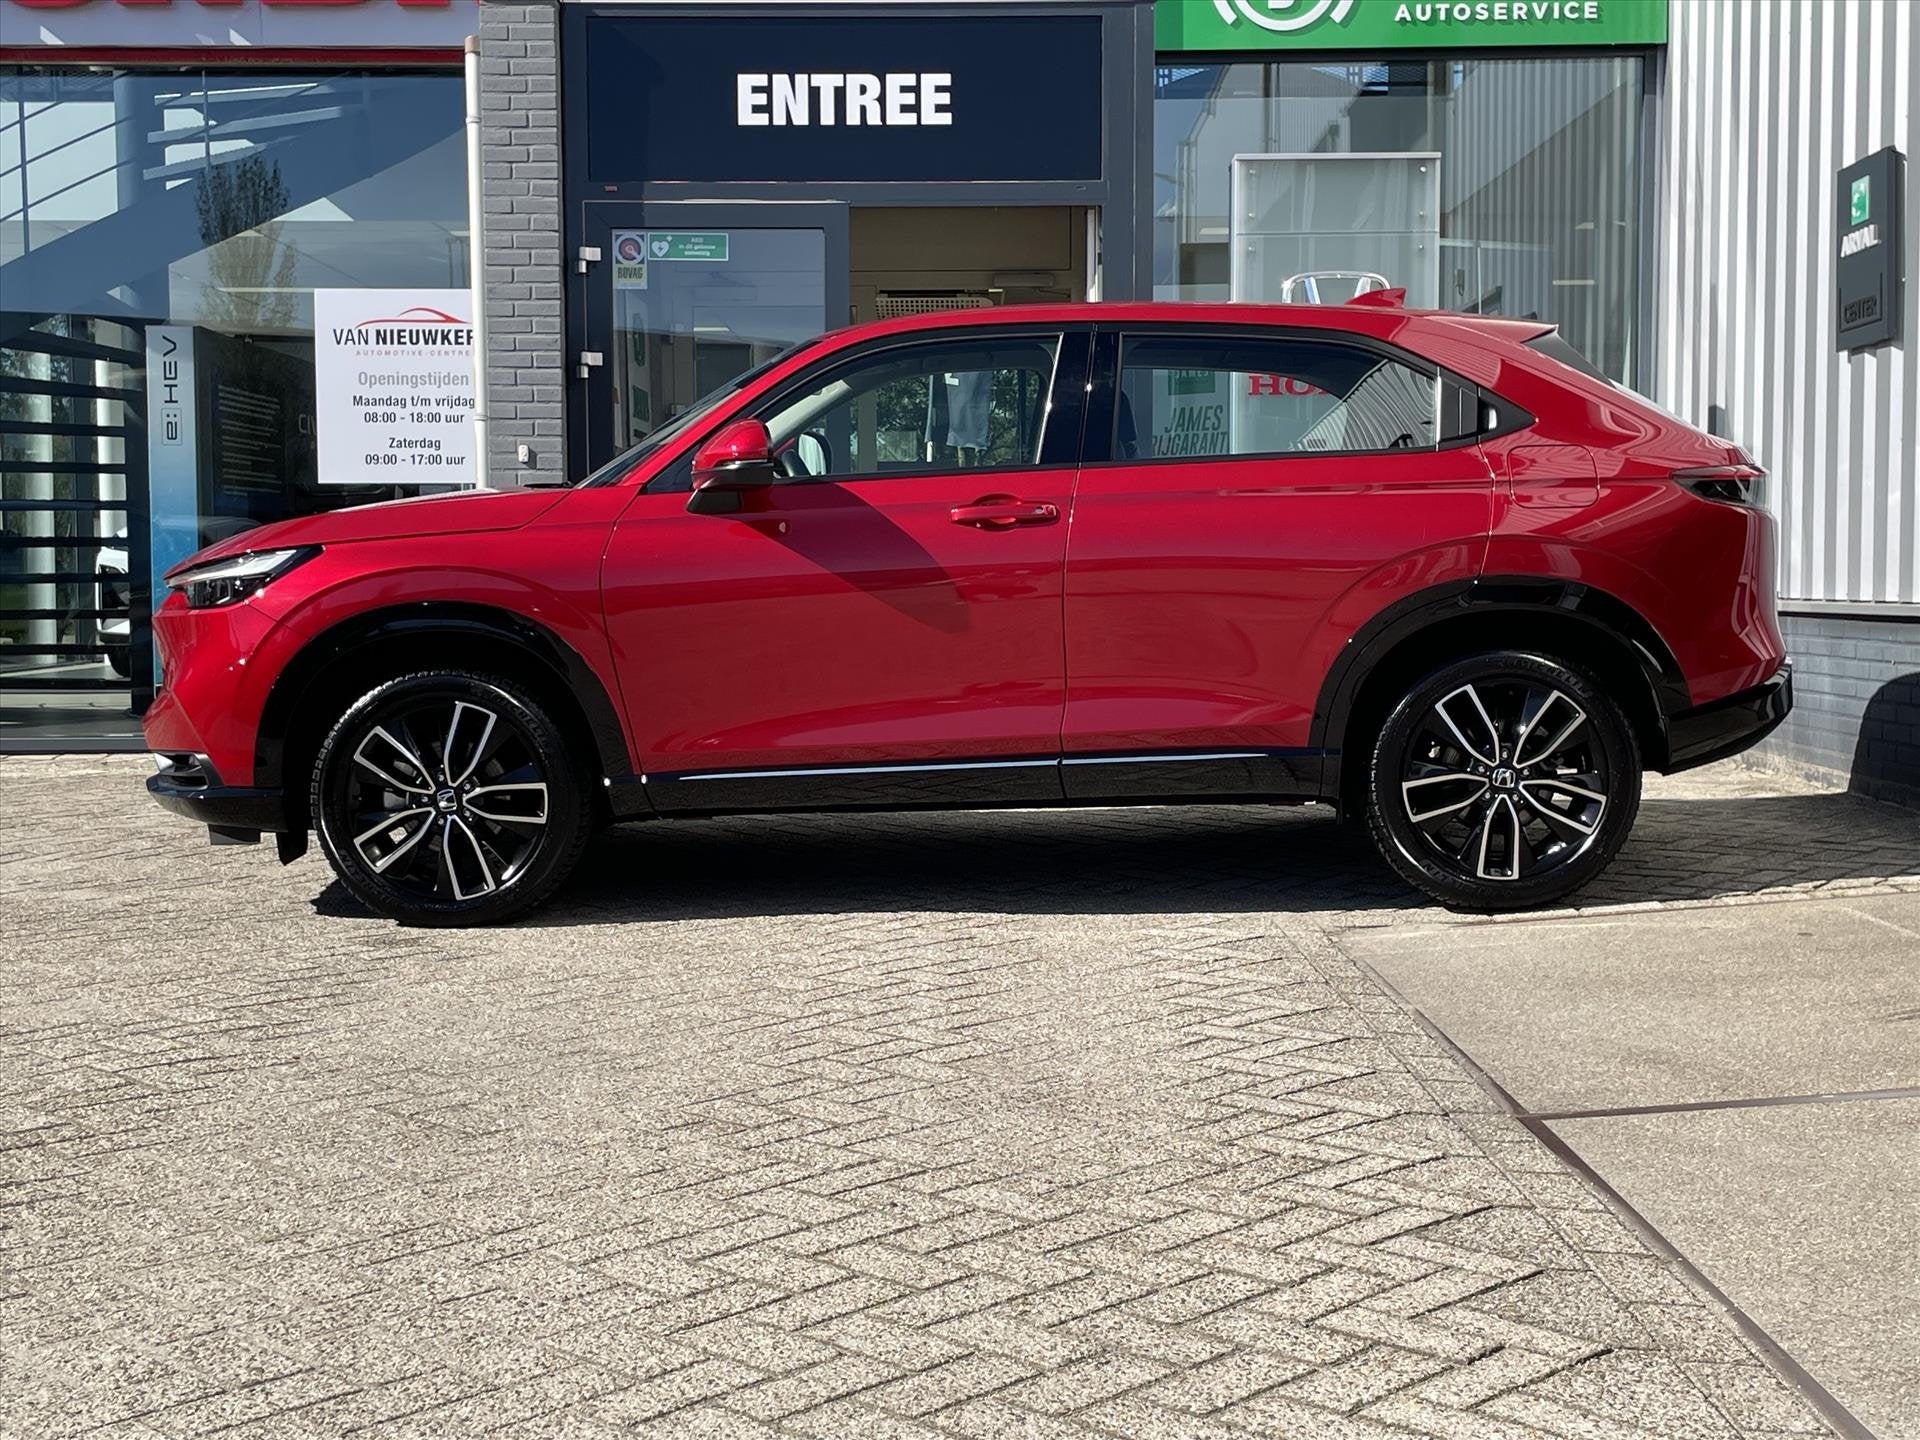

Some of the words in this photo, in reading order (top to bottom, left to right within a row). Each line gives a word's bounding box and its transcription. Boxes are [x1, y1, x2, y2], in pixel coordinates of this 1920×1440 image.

[1394, 1, 1599, 21] AUTOSERVICE
[737, 73, 952, 126] ENTREE
[1840, 223, 1880, 258] ARVAL
[617, 266, 644, 279] BOVAG
[333, 328, 369, 346] VAN
[358, 371, 470, 388] Openingstijden
[1248, 373, 1329, 396] HO
[352, 395, 407, 408] Maandag
[410, 395, 431, 407] t/m
[435, 395, 475, 408] vrijdag
[364, 412, 397, 423] 08:00
[409, 412, 441, 423] 18:00
[445, 414, 465, 423] uur
[1164, 405, 1224, 434] JAMES
[389, 437, 441, 450] Zaterdag
[365, 454, 397, 465] 09:00
[410, 454, 442, 465] 17:00
[446, 456, 466, 465] uur
